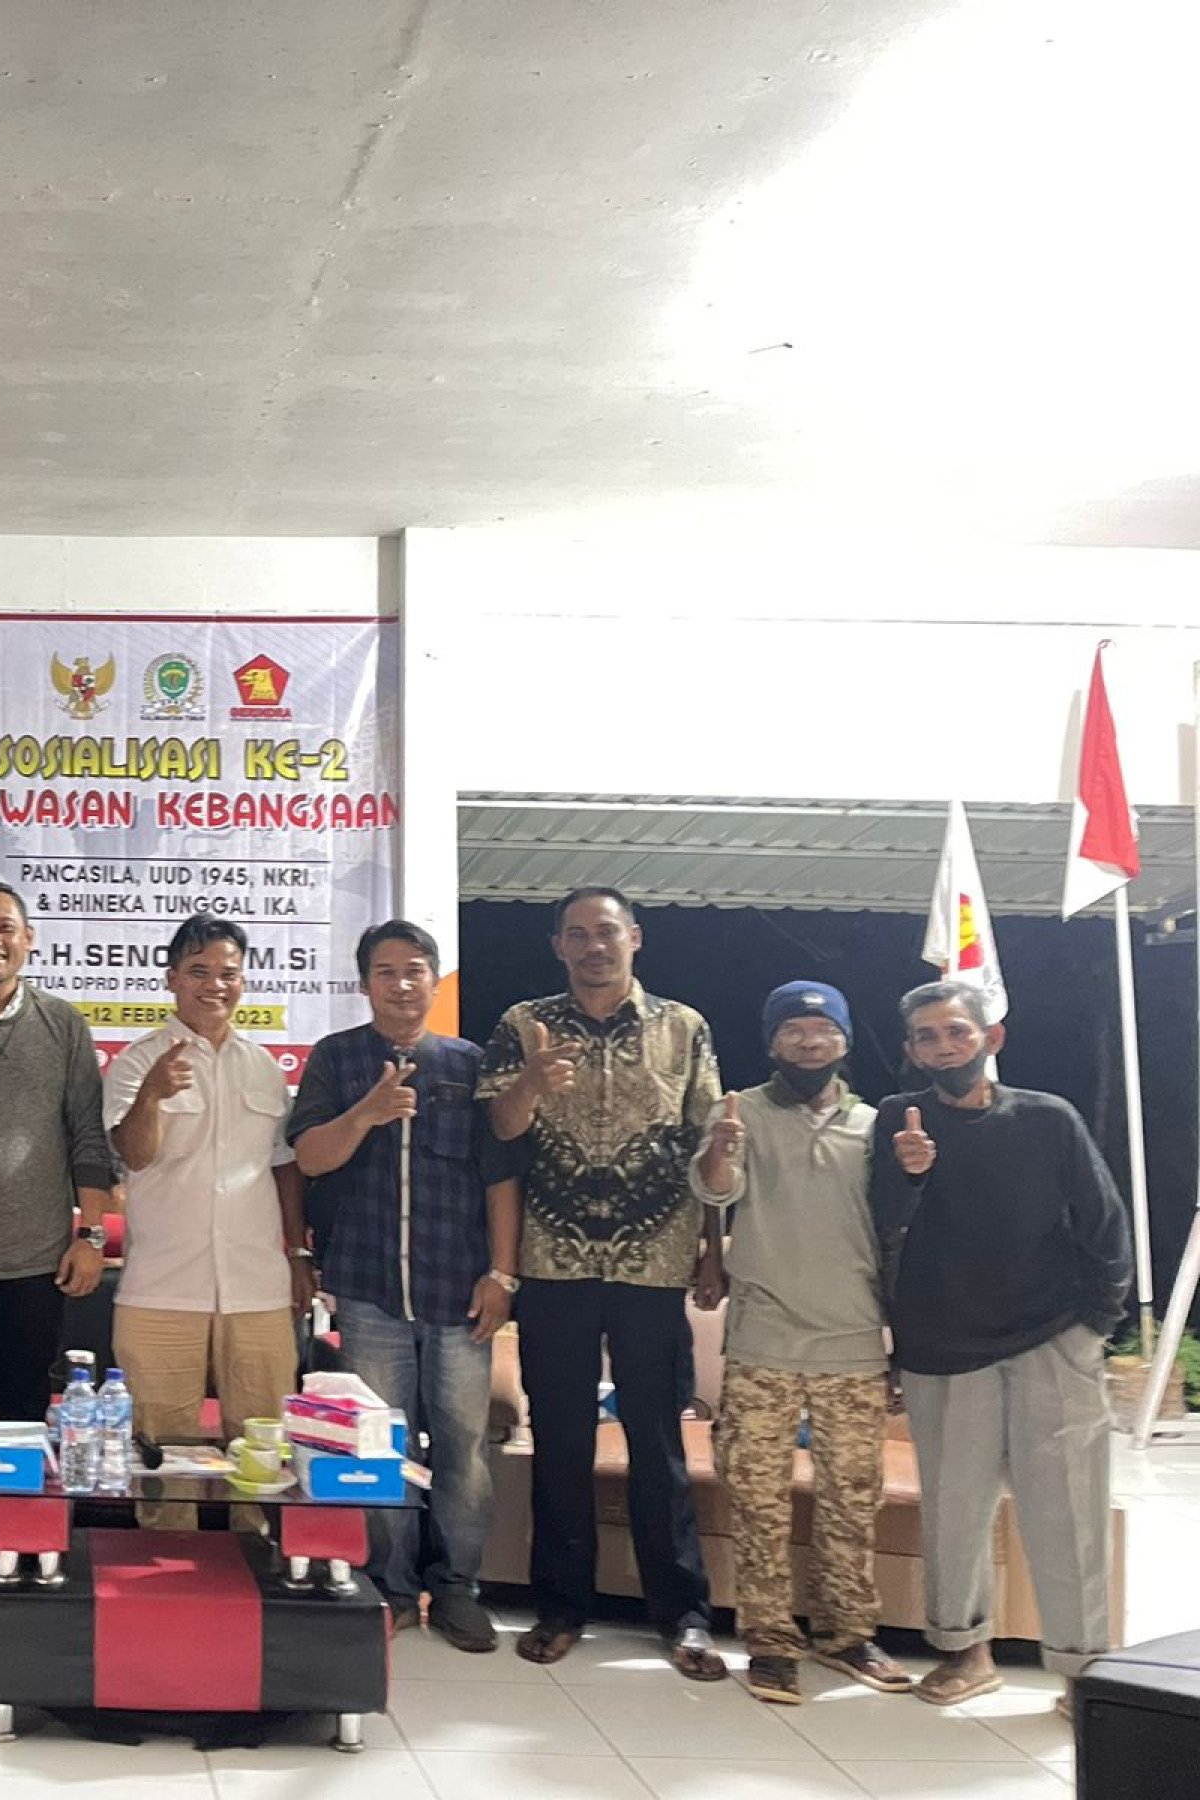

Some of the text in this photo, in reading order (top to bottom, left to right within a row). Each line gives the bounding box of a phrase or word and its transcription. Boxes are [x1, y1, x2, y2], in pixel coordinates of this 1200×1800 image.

[245, 737, 349, 782] KE-2
[157, 791, 399, 829] KEBANGSAAN
[21, 863, 316, 890] PANCASILA, UUD 1945, NKRI,
[38, 893, 298, 915] & BHINEKA TUNGGAL IKA
[28, 943, 316, 970] r.H.SENO M.Si
[24, 975, 66, 990] ETUA
[72, 976, 119, 991] DPRD
[327, 981, 358, 995] TIM
[84, 1007, 272, 1024] -12 FEBR 023
